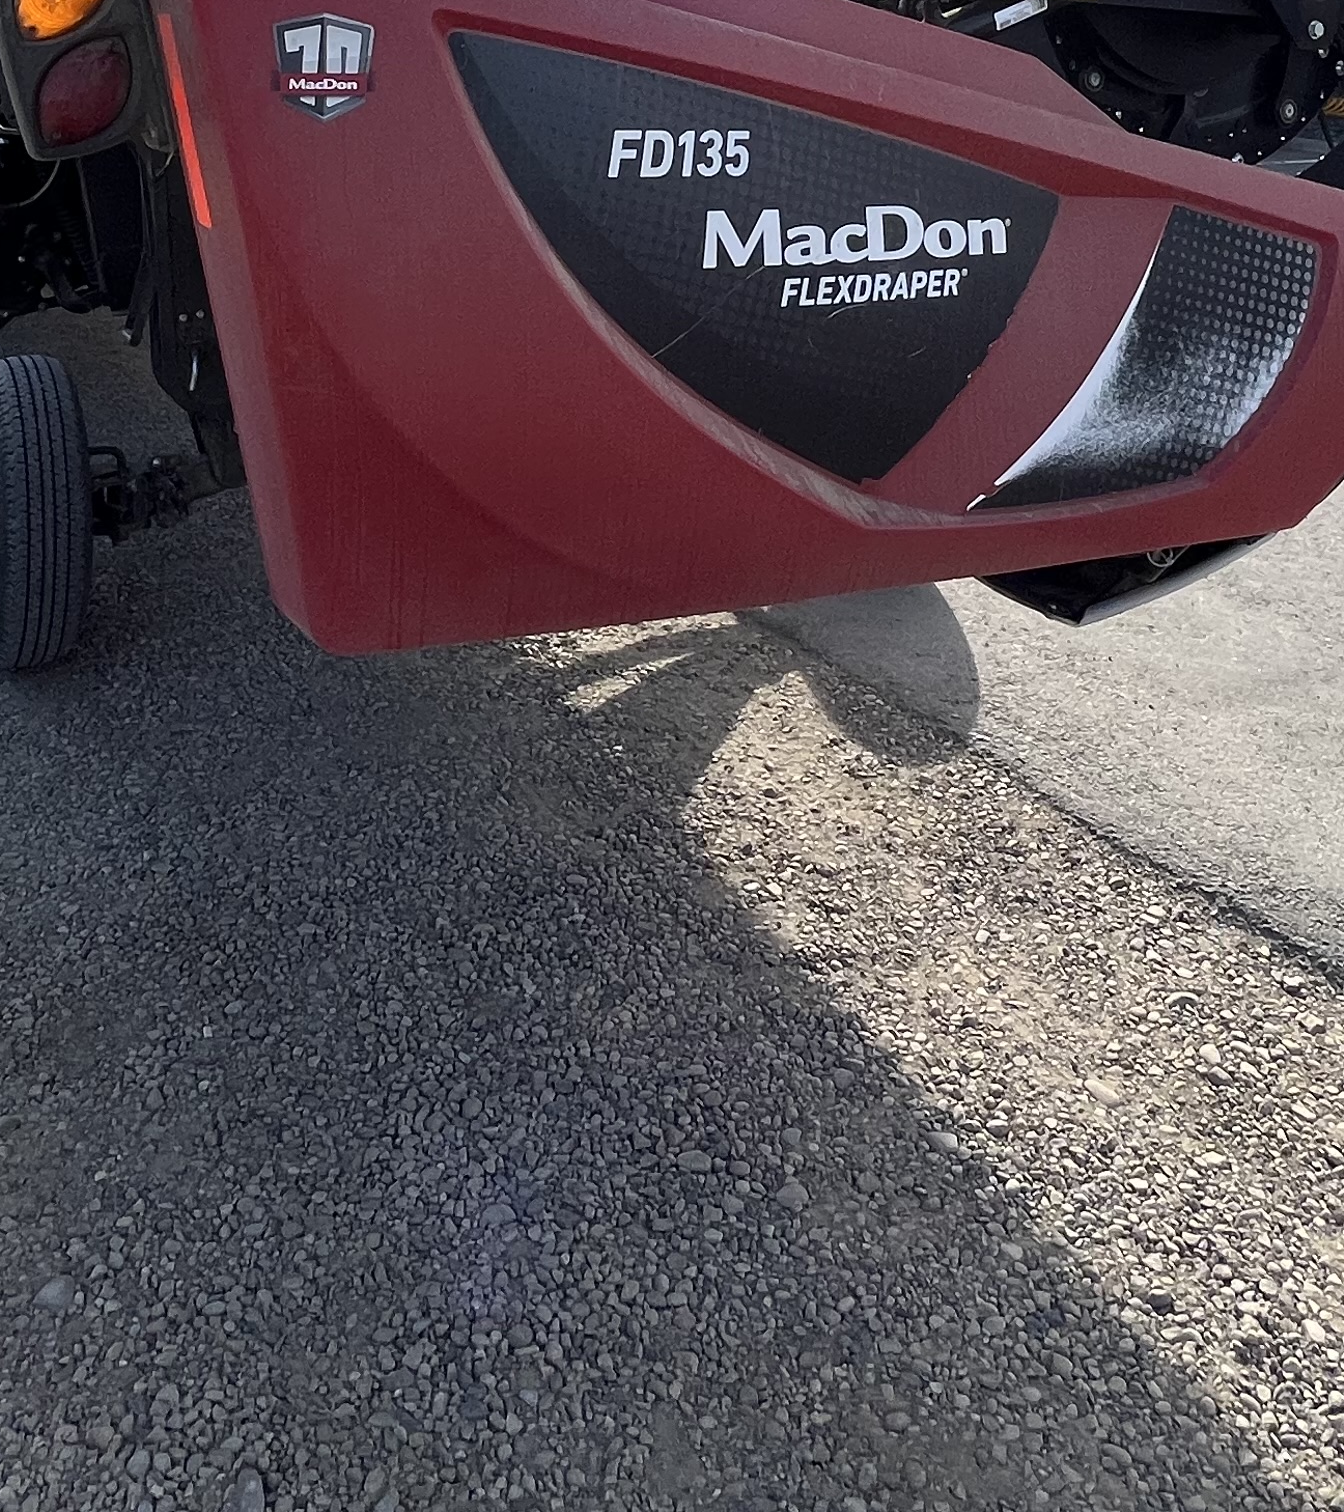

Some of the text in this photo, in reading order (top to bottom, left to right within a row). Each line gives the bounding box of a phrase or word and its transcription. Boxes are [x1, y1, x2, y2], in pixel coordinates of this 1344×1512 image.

[288, 78, 358, 90] MacDon
[607, 129, 751, 179] FD135
[702, 205, 1008, 270] MacDon
[780, 270, 962, 308] FLEXDRAPER
